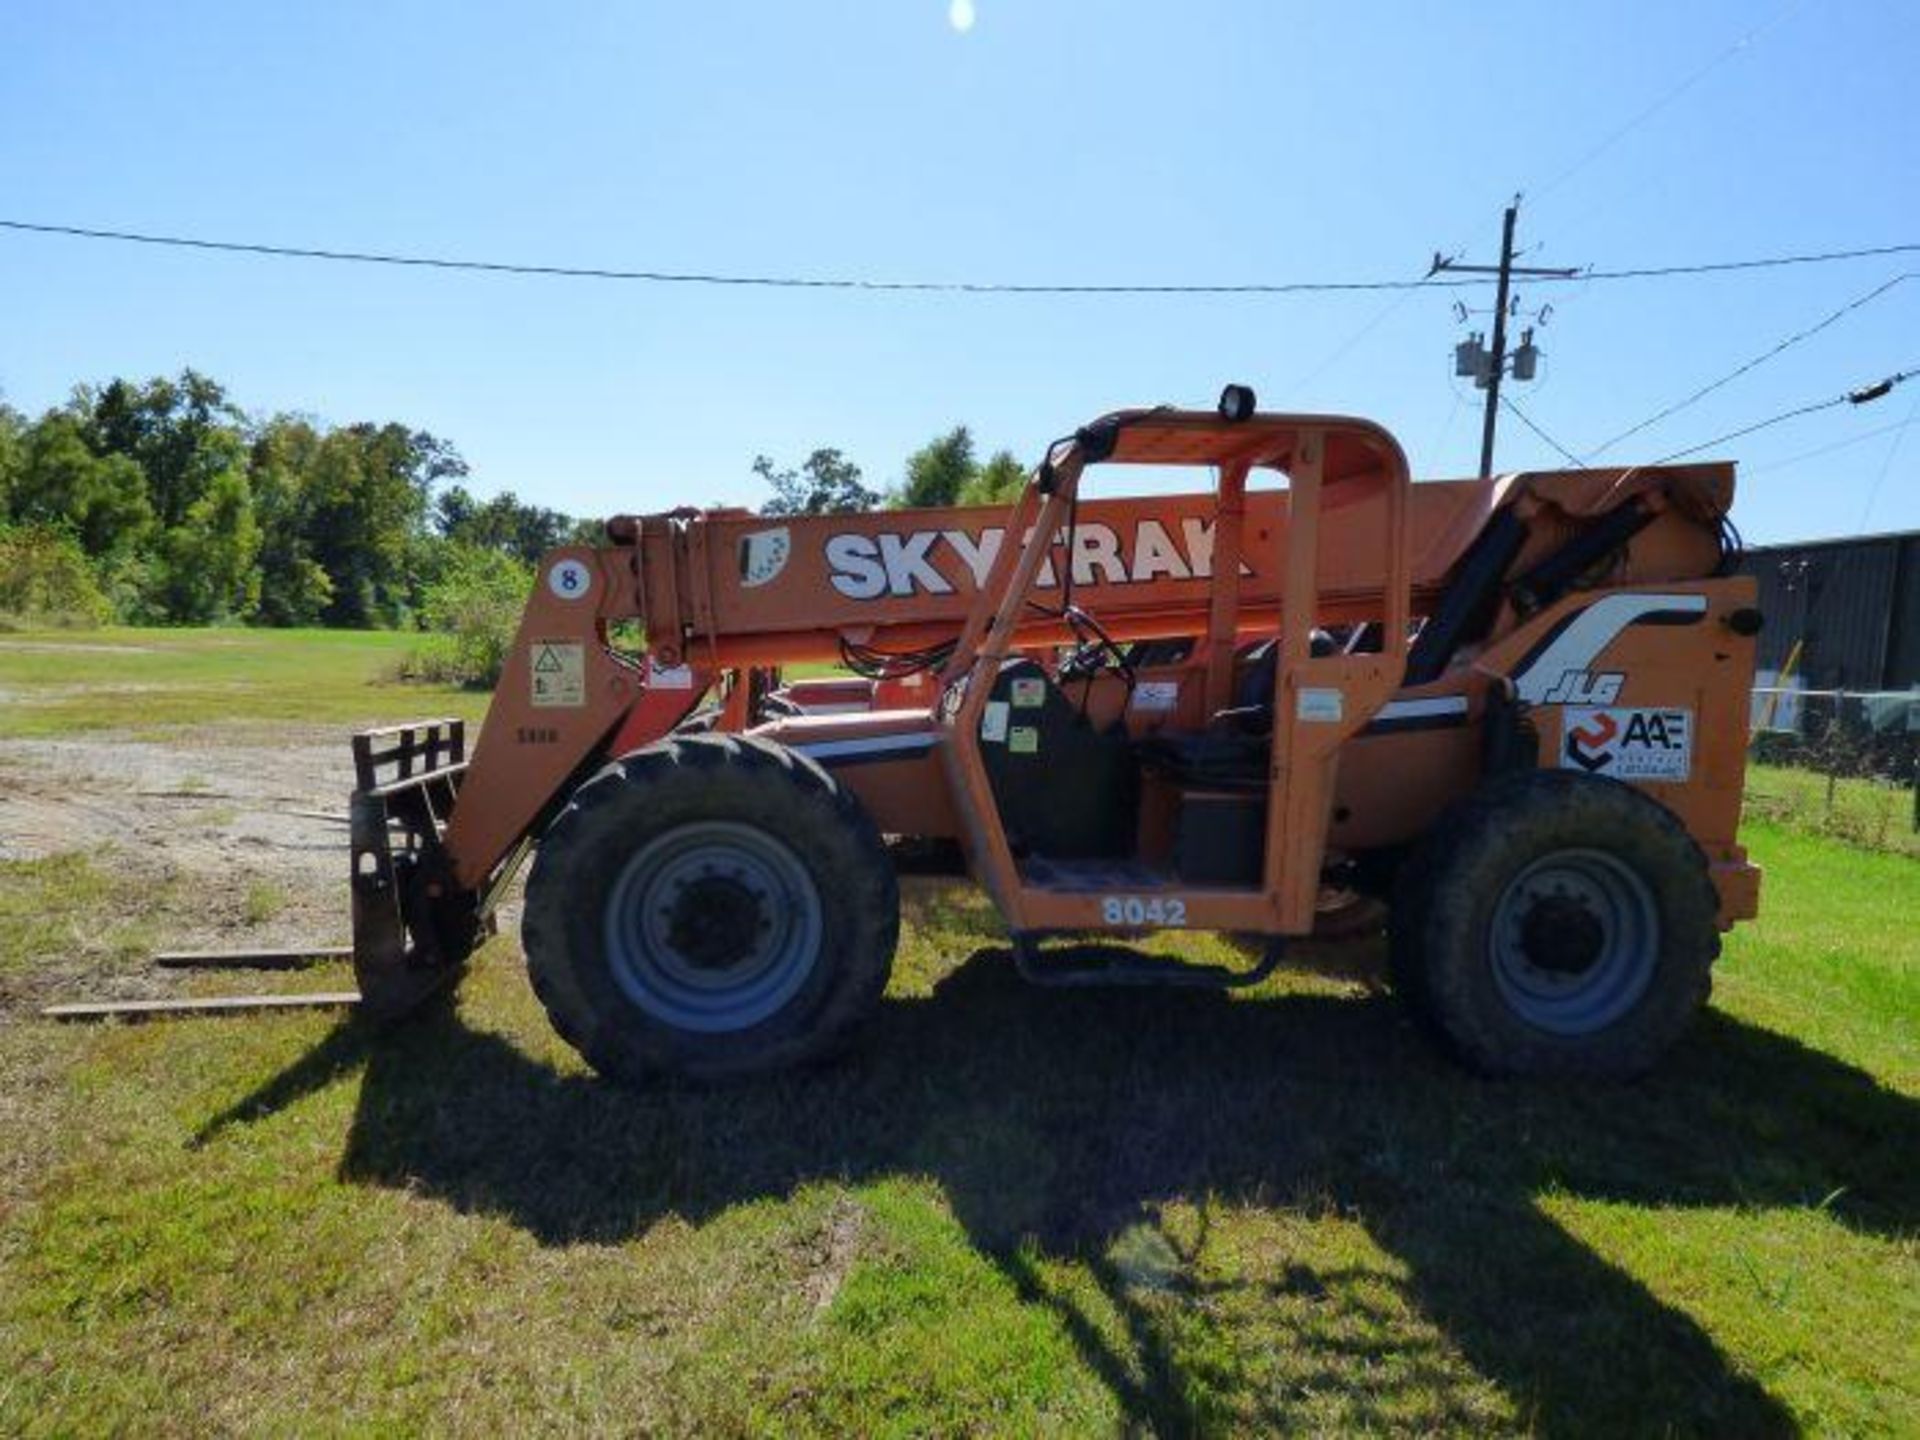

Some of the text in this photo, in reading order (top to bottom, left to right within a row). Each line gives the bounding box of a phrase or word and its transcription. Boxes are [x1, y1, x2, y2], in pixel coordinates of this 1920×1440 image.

[561, 570, 577, 591] 8
[1544, 668, 1627, 705] JLG
[1620, 712, 1684, 749] AAE
[1103, 898, 1186, 925] 8042
